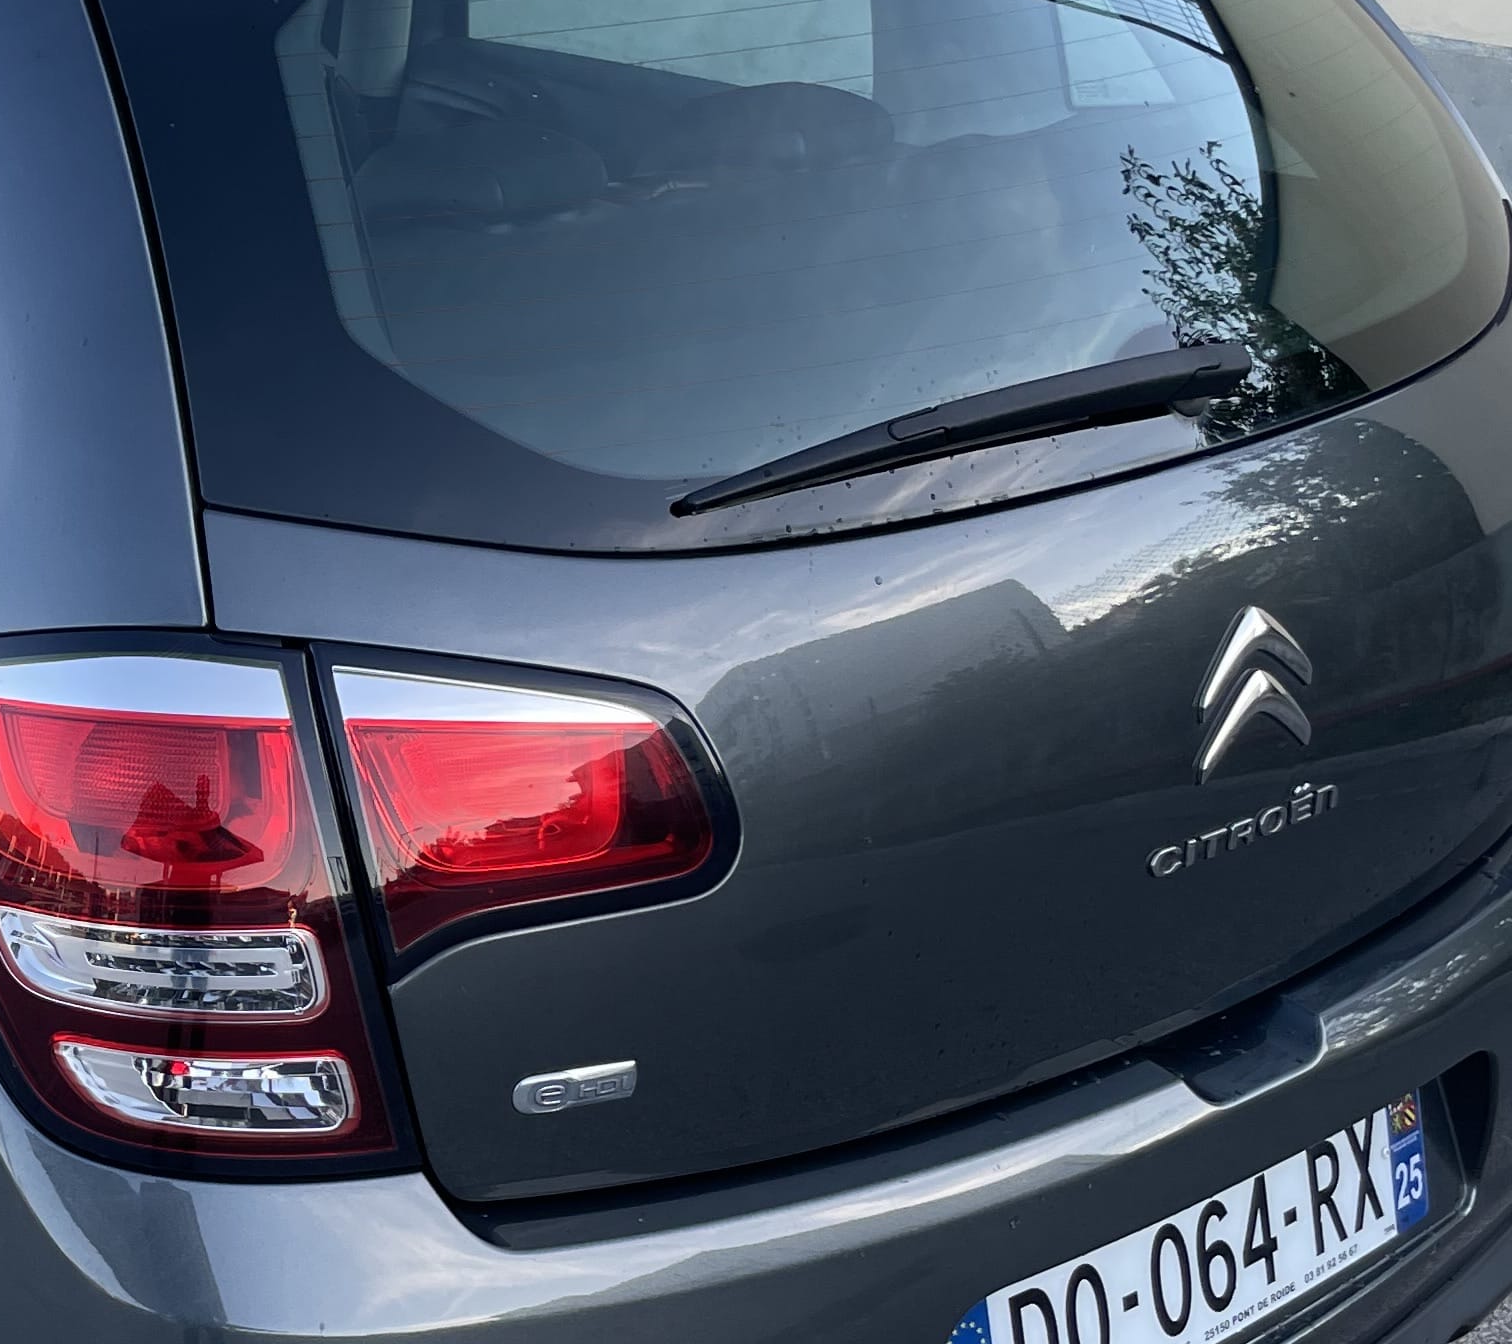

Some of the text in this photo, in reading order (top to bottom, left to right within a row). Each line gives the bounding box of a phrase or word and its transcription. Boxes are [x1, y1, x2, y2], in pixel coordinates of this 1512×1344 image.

[1395, 1153, 1423, 1210] 25
[1204, 1319, 1230, 1341] 25150
[1232, 1306, 1254, 1325] PONT
[1257, 1298, 1269, 1311] DE
[1270, 1281, 1296, 1302] ROIDE
